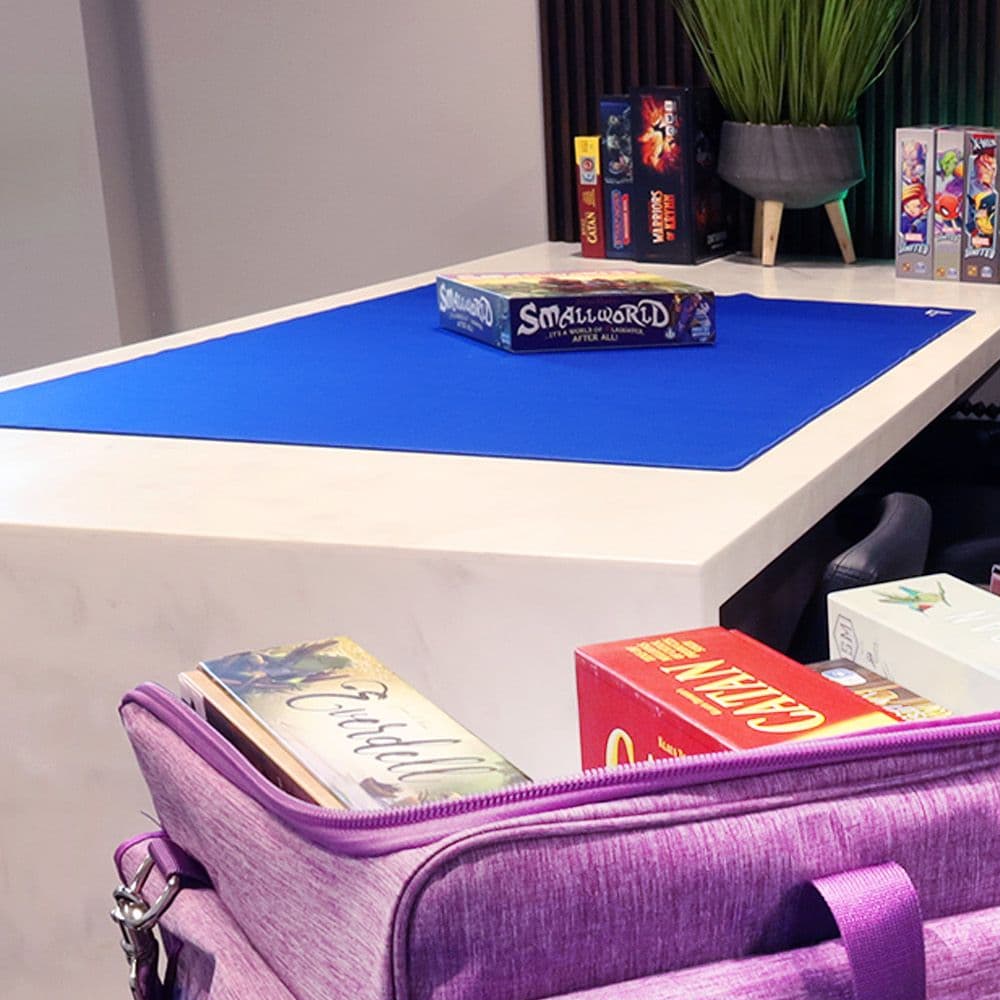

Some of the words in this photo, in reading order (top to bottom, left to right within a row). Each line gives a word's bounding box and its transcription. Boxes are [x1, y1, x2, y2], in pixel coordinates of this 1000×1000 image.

[517, 299, 670, 336] SMALLWORLD
[286, 679, 498, 782] Everdell
[659, 658, 827, 734] CATAN
